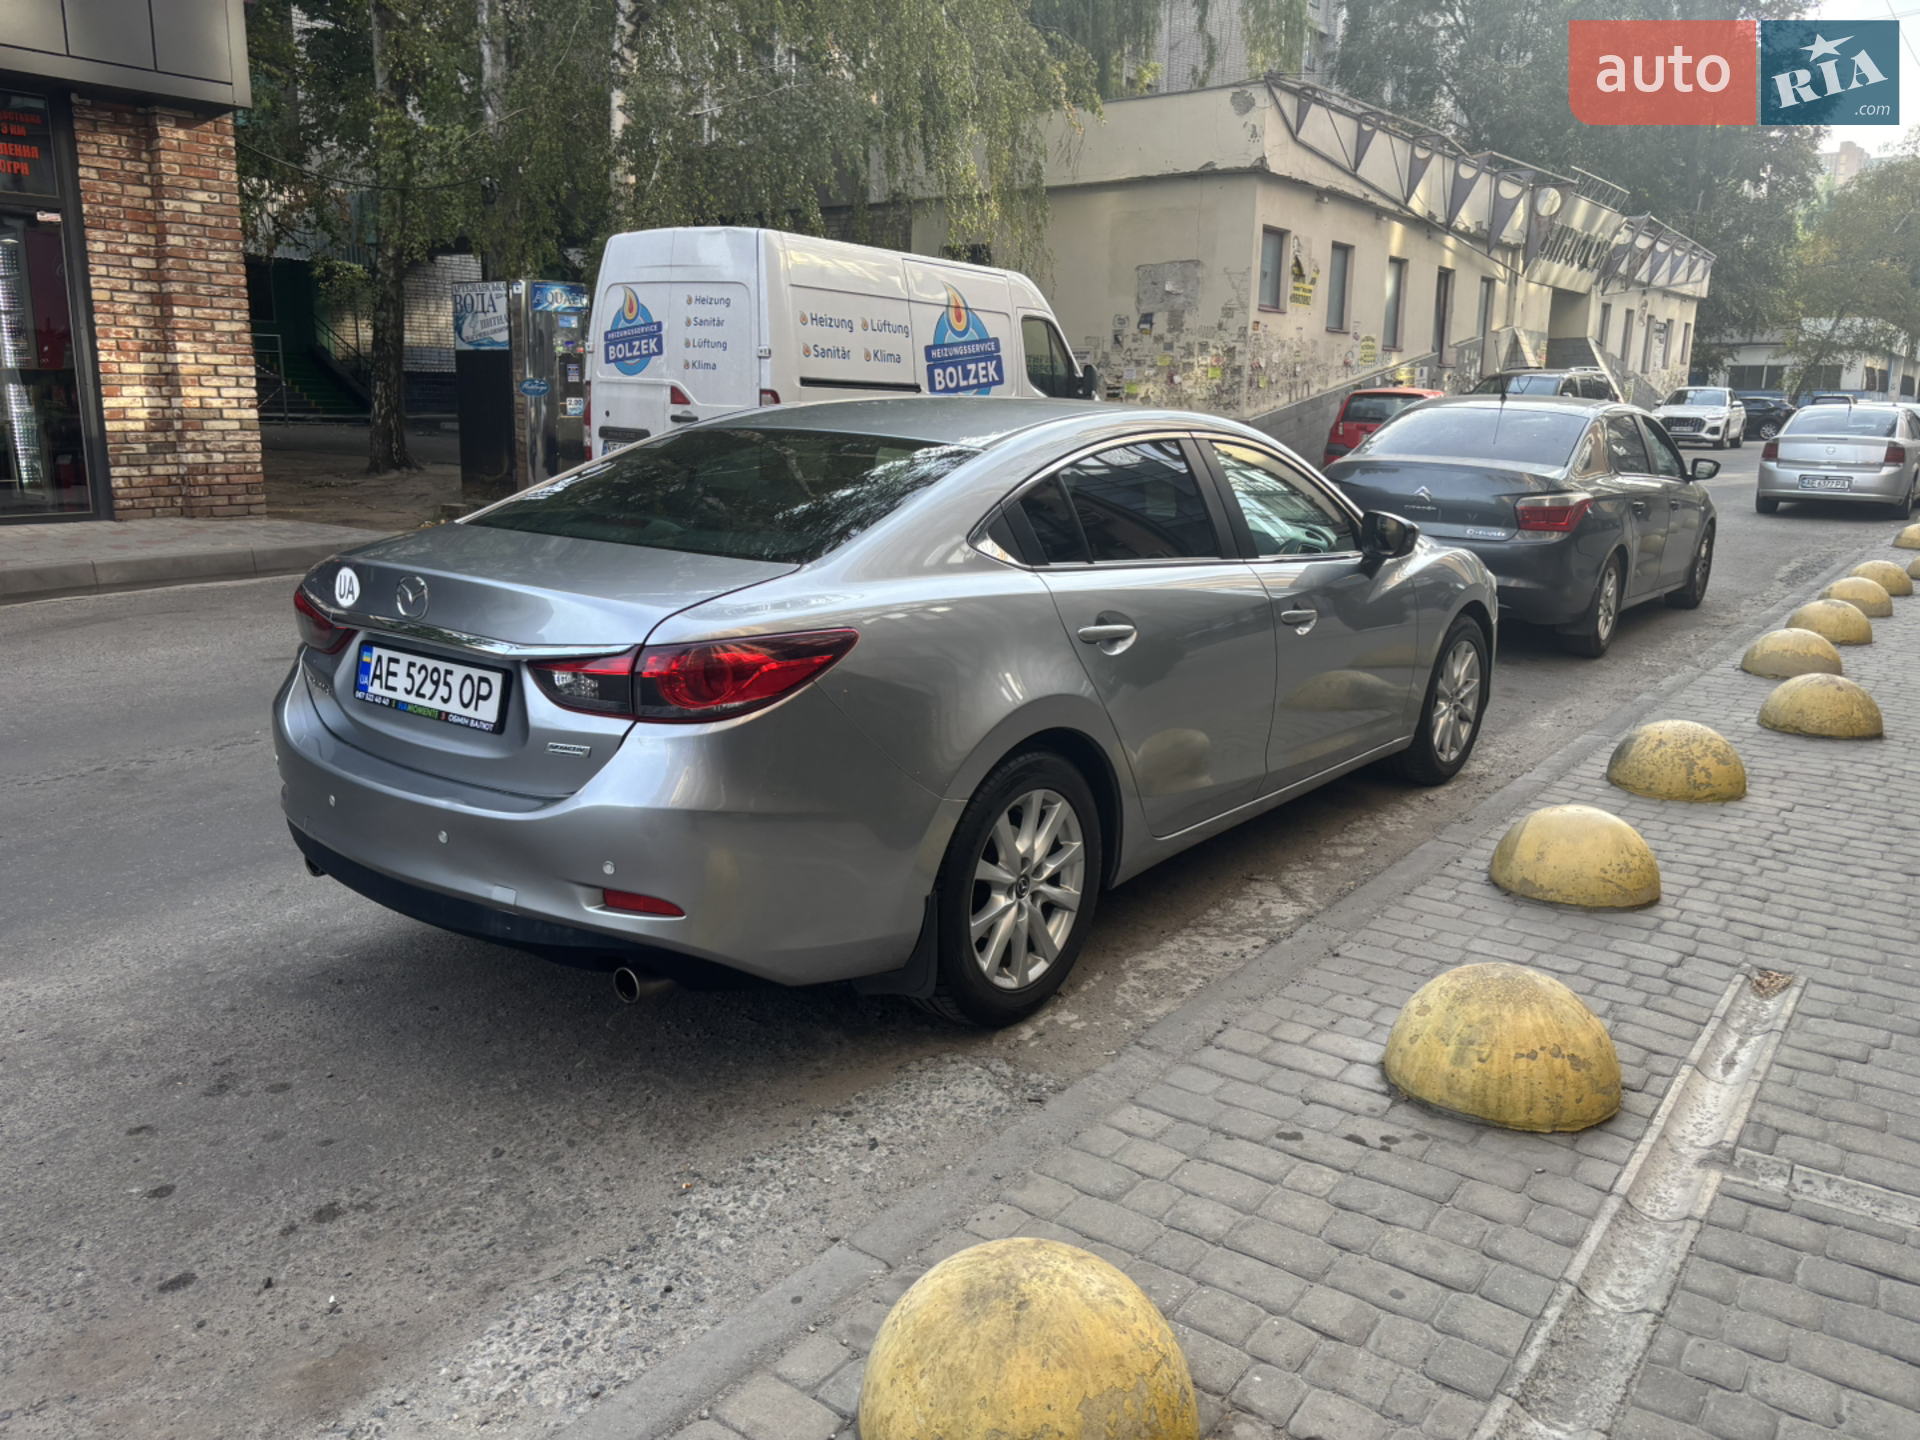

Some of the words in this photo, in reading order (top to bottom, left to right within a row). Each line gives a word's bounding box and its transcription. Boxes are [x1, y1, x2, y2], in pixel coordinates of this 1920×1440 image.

[453, 292, 498, 317] ВОДА
[694, 295, 731, 308] Heizung
[693, 316, 725, 327] Sanitär
[810, 312, 854, 333] Heizung
[870, 318, 909, 338] Lüftung
[607, 324, 658, 340] HEIZUNGSSERVICE
[608, 337, 659, 360] BOLZEK
[692, 338, 728, 351] Lüftung
[812, 344, 851, 360] Sanitär
[931, 341, 996, 359] HEIZUNGSSERVICE
[691, 359, 717, 370] Klima
[872, 348, 901, 364] Klima
[933, 360, 1000, 391] BOLZEK
[339, 573, 356, 601] UA
[359, 674, 369, 686] UA
[370, 654, 400, 692] AE
[404, 661, 454, 704] 5295
[459, 673, 493, 712] OP
